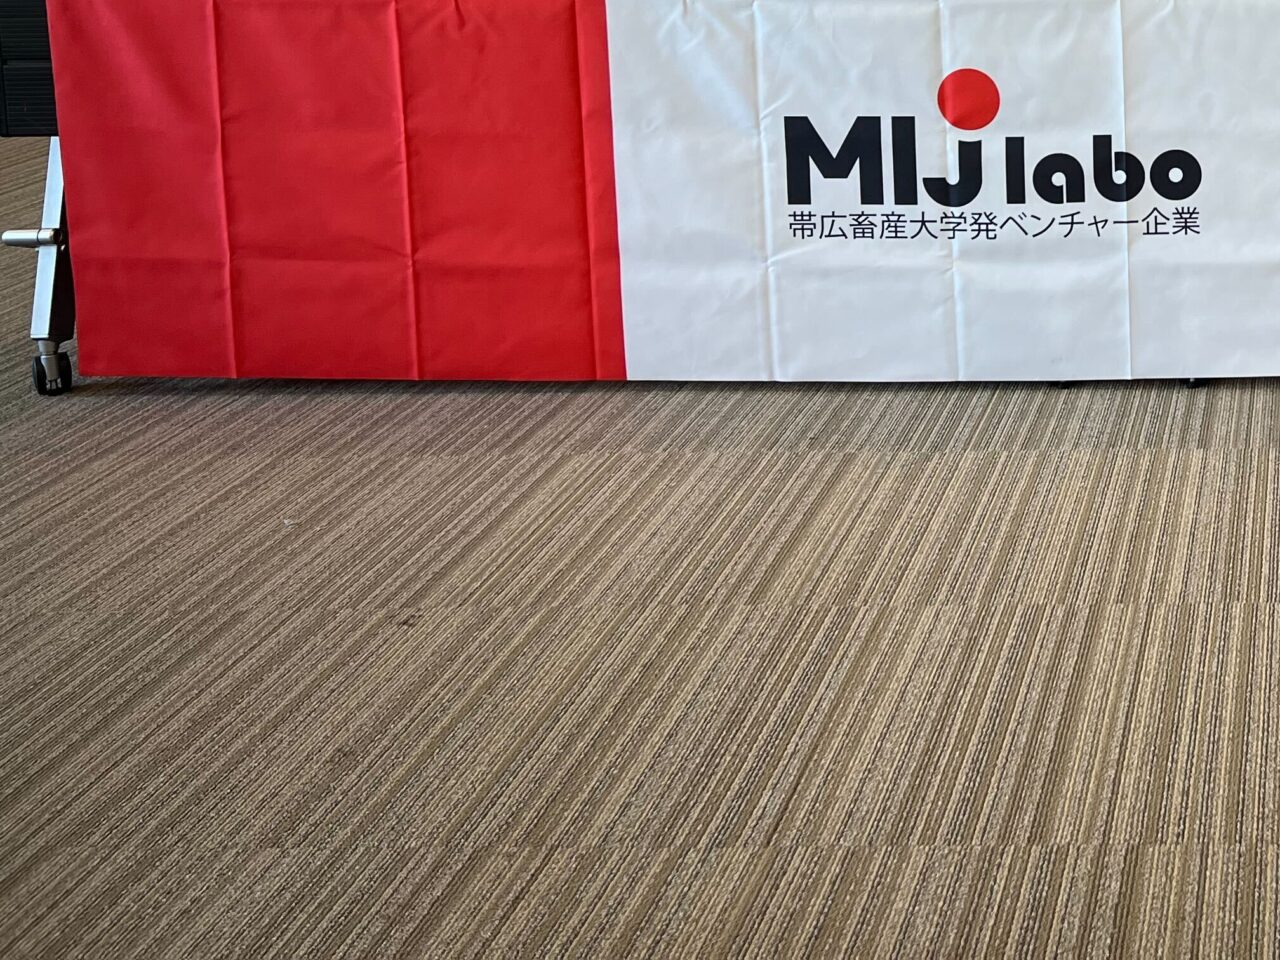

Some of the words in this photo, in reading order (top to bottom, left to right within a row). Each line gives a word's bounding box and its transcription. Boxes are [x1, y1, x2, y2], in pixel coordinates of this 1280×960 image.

[1005, 134, 1202, 205] labo
[788, 206, 1201, 240] 帯広畜産大学発ベンチャー企業
